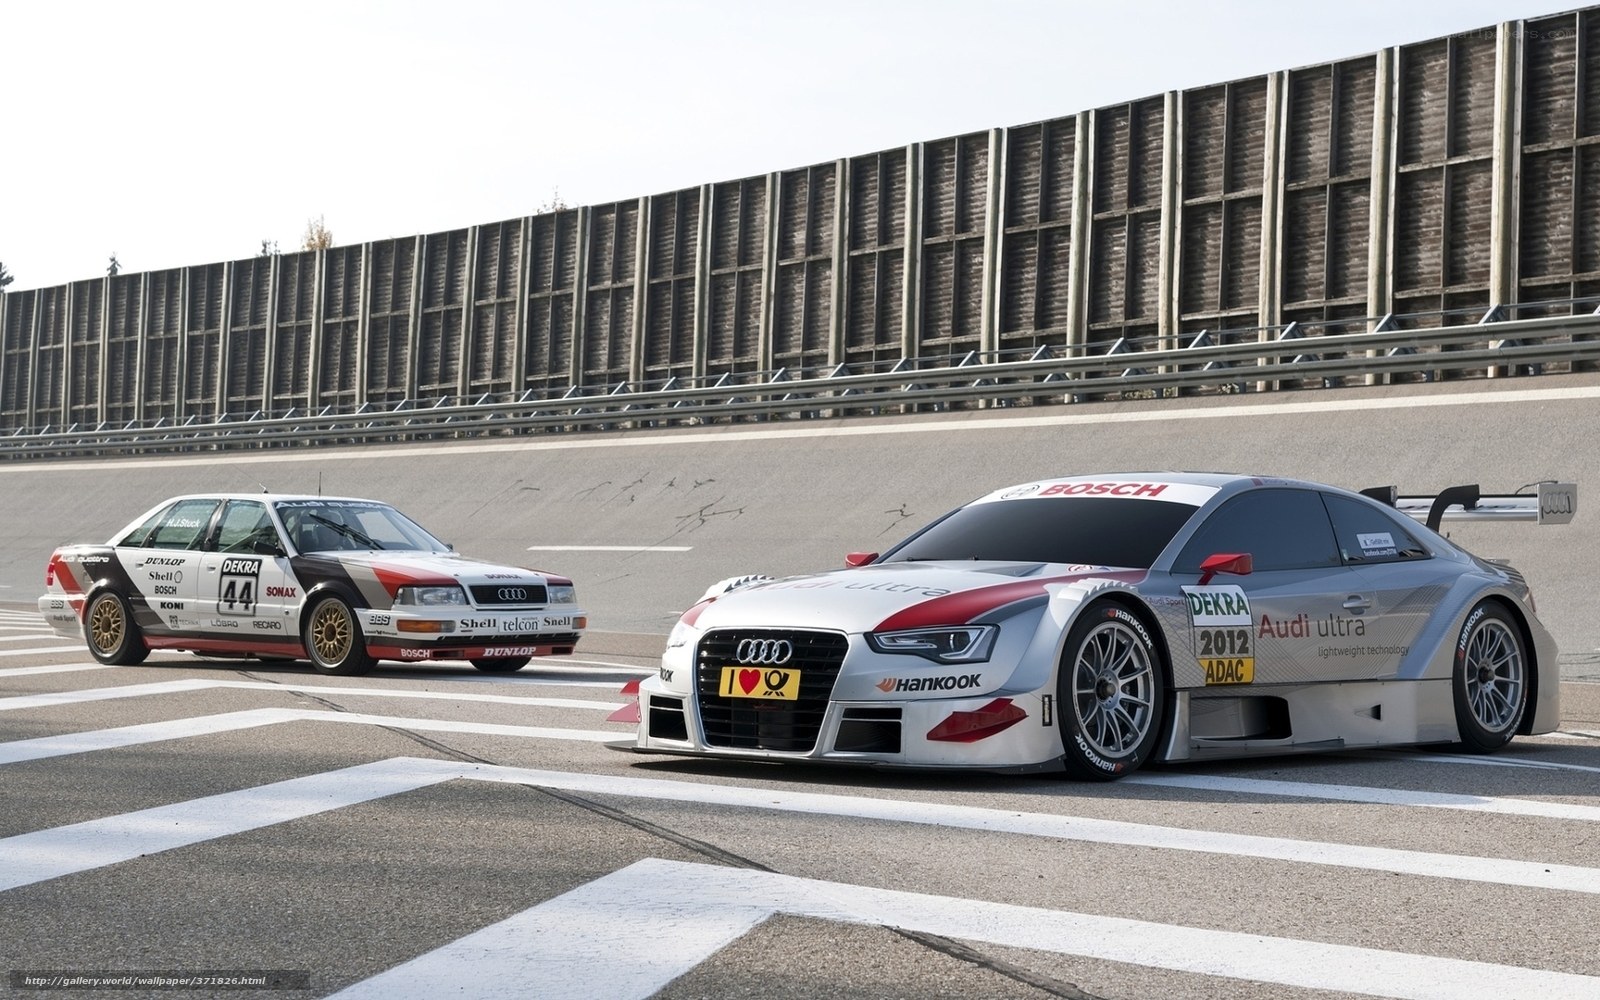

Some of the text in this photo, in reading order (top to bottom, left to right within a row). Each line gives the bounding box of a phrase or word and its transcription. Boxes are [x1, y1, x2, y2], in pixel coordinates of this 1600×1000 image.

[1038, 483, 1168, 497] BOSCH
[145, 557, 186, 566] DUNLOP
[222, 560, 259, 574] DEKRA
[148, 571, 173, 581] Shell
[154, 585, 177, 595] BOSCH
[266, 586, 297, 598] SONAX
[845, 581, 952, 597] ultra
[223, 580, 253, 611] 44
[160, 601, 184, 610] KONI
[1187, 591, 1250, 616] DEKRA
[253, 621, 281, 630] RECARO
[369, 614, 391, 626] BBS
[459, 618, 497, 629] Shell
[503, 616, 538, 632] telcon
[1258, 613, 1366, 639] Audi ultra
[1200, 629, 1249, 656] 2012
[400, 648, 431, 658] BOSCH
[483, 646, 536, 657] DUNLOP
[1318, 645, 1410, 658] lightweight technology
[1205, 659, 1244, 683] ADAC
